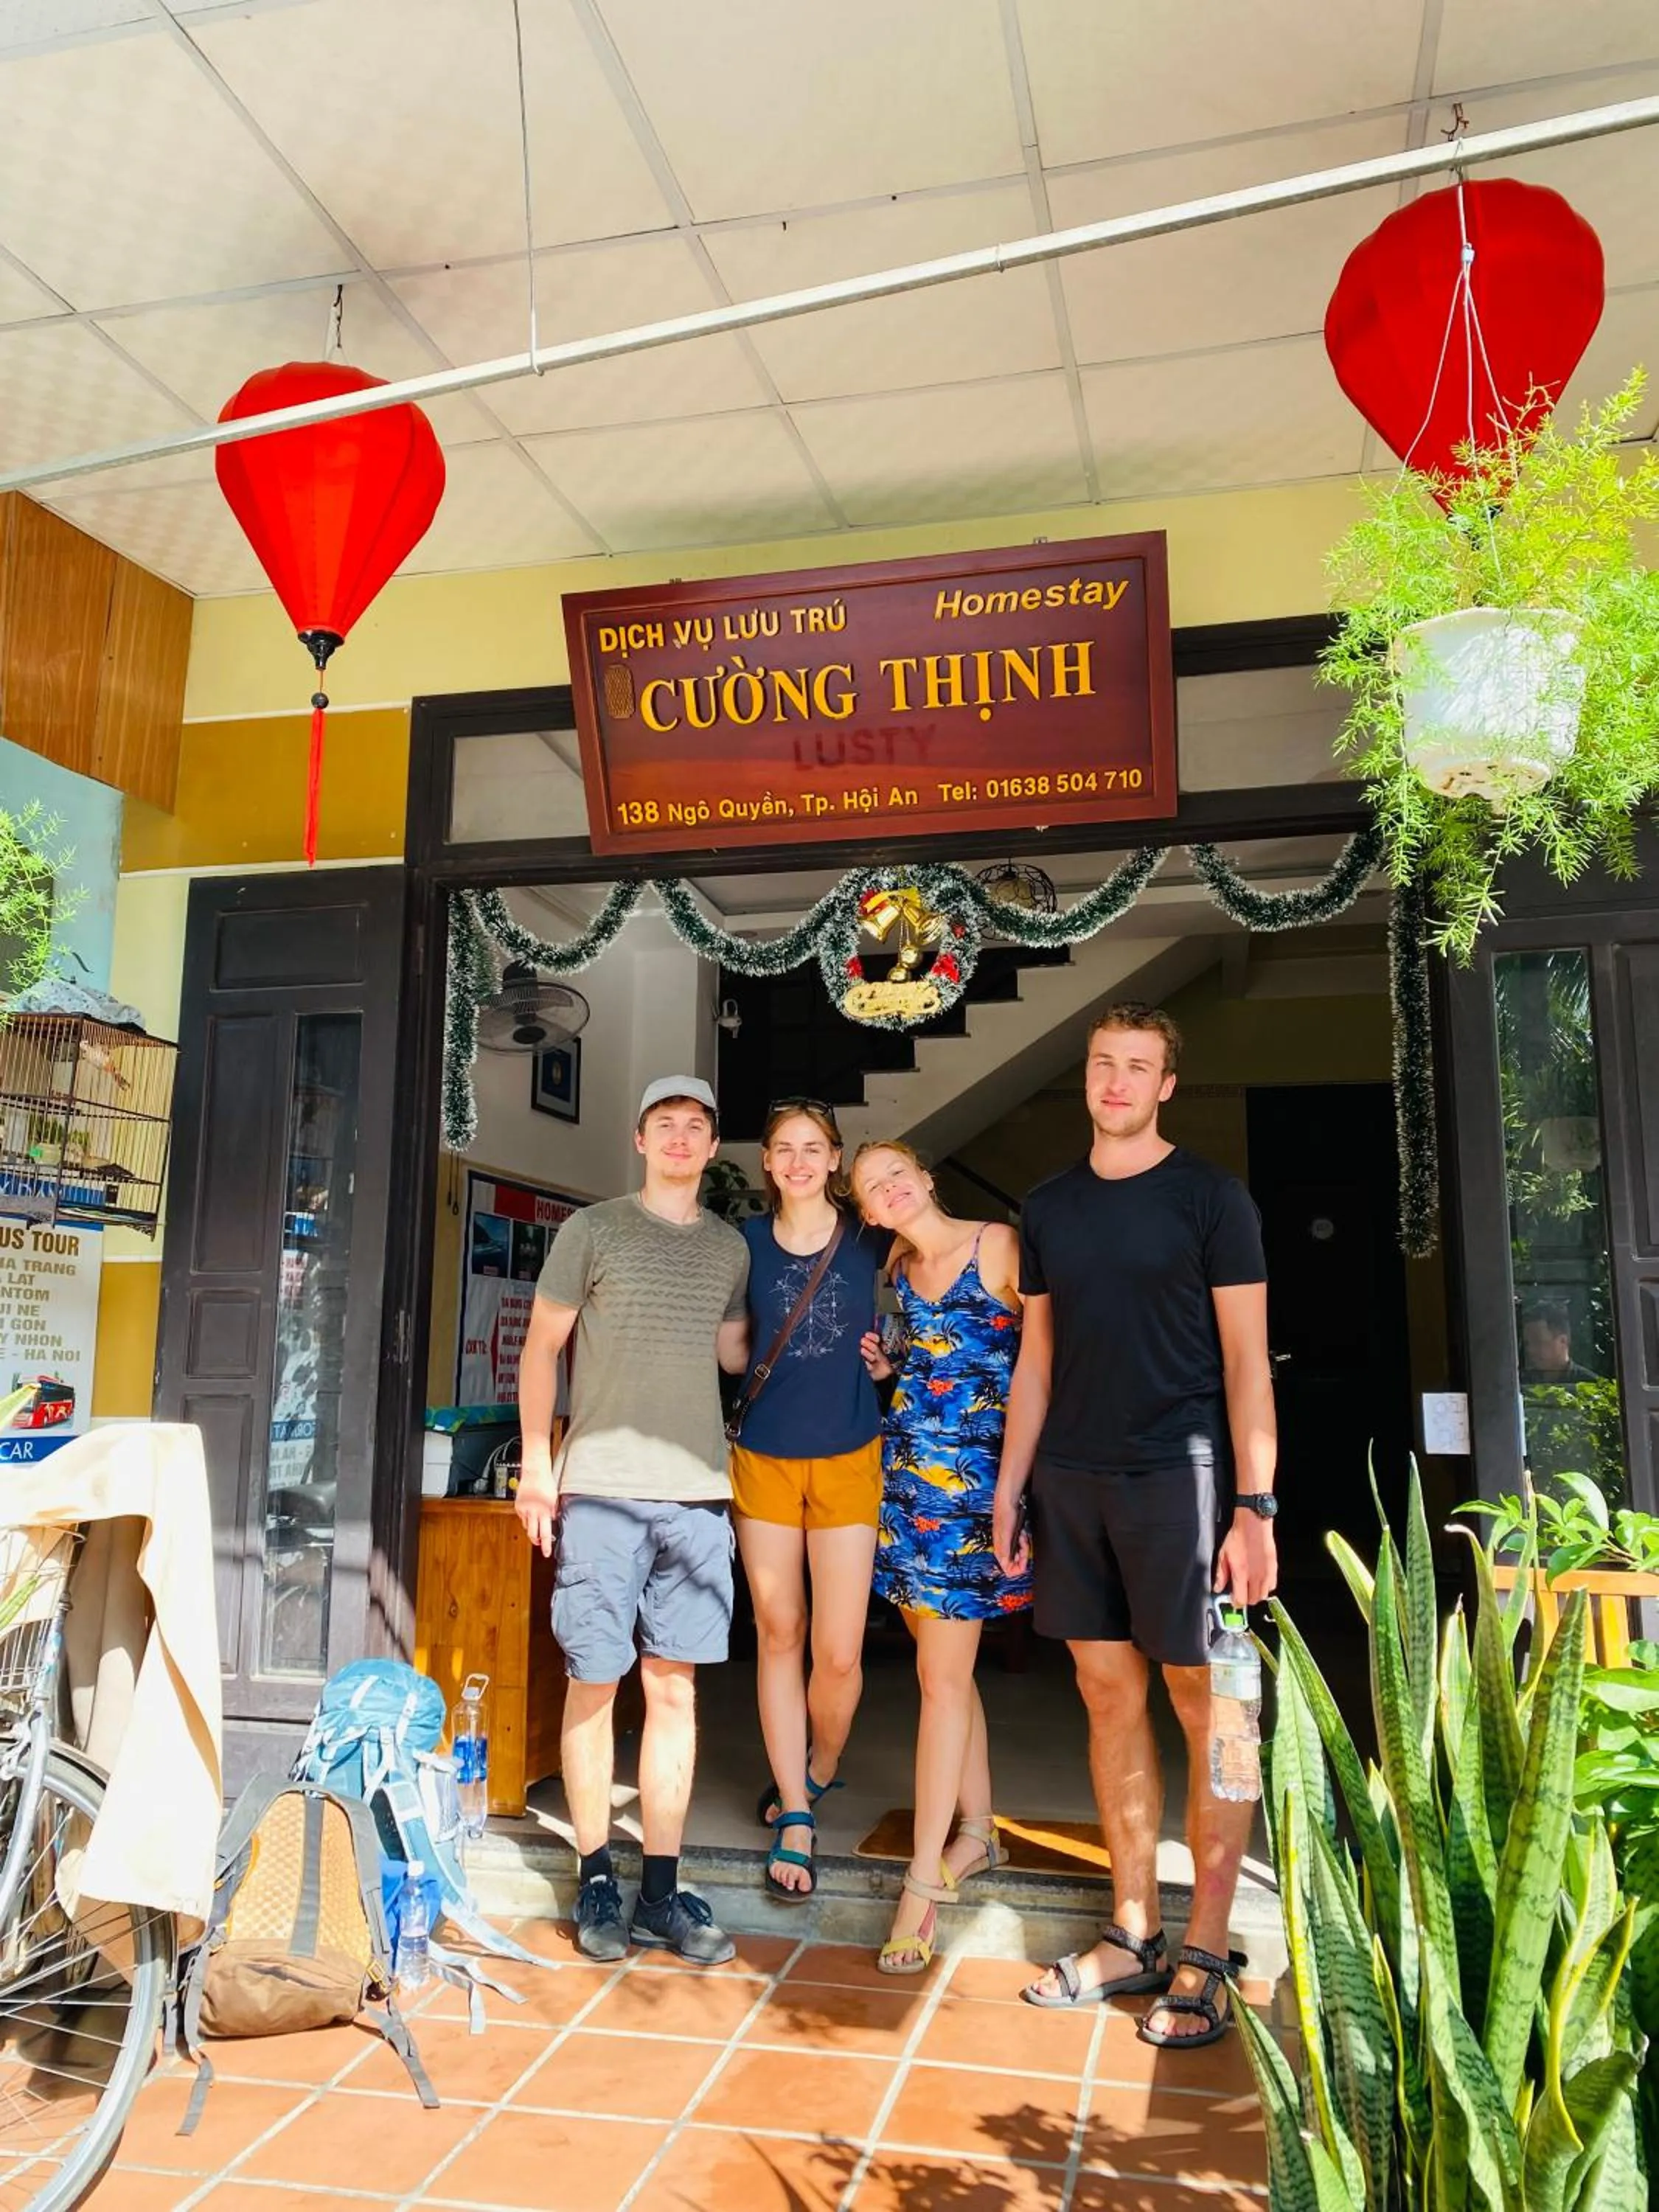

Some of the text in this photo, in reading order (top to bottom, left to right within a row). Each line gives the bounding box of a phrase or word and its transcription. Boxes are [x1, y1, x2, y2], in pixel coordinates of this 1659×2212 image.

[934, 577, 1130, 620] Homestay
[599, 599, 846, 658] DỊCH VỤ LƯU TRÚ
[640, 641, 1096, 732] CƯỜNG THỊNH
[618, 768, 1142, 826] 138 Ngô Quyền, Tp. Hội An Tel: 01638 504 710
[536, 1198, 576, 1223] HOMES
[32, 1231, 79, 1256] TOUR
[24, 1259, 76, 1276] TRANG
[8, 1273, 35, 1286] LAT
[1, 1286, 50, 1301] NTOM
[17, 1304, 41, 1316] NE
[10, 1318, 46, 1332] GON
[15, 1333, 62, 1347] NHON
[24, 1349, 46, 1361] HA
[52, 1349, 80, 1362] NOI
[0, 1441, 33, 1460] CAR
